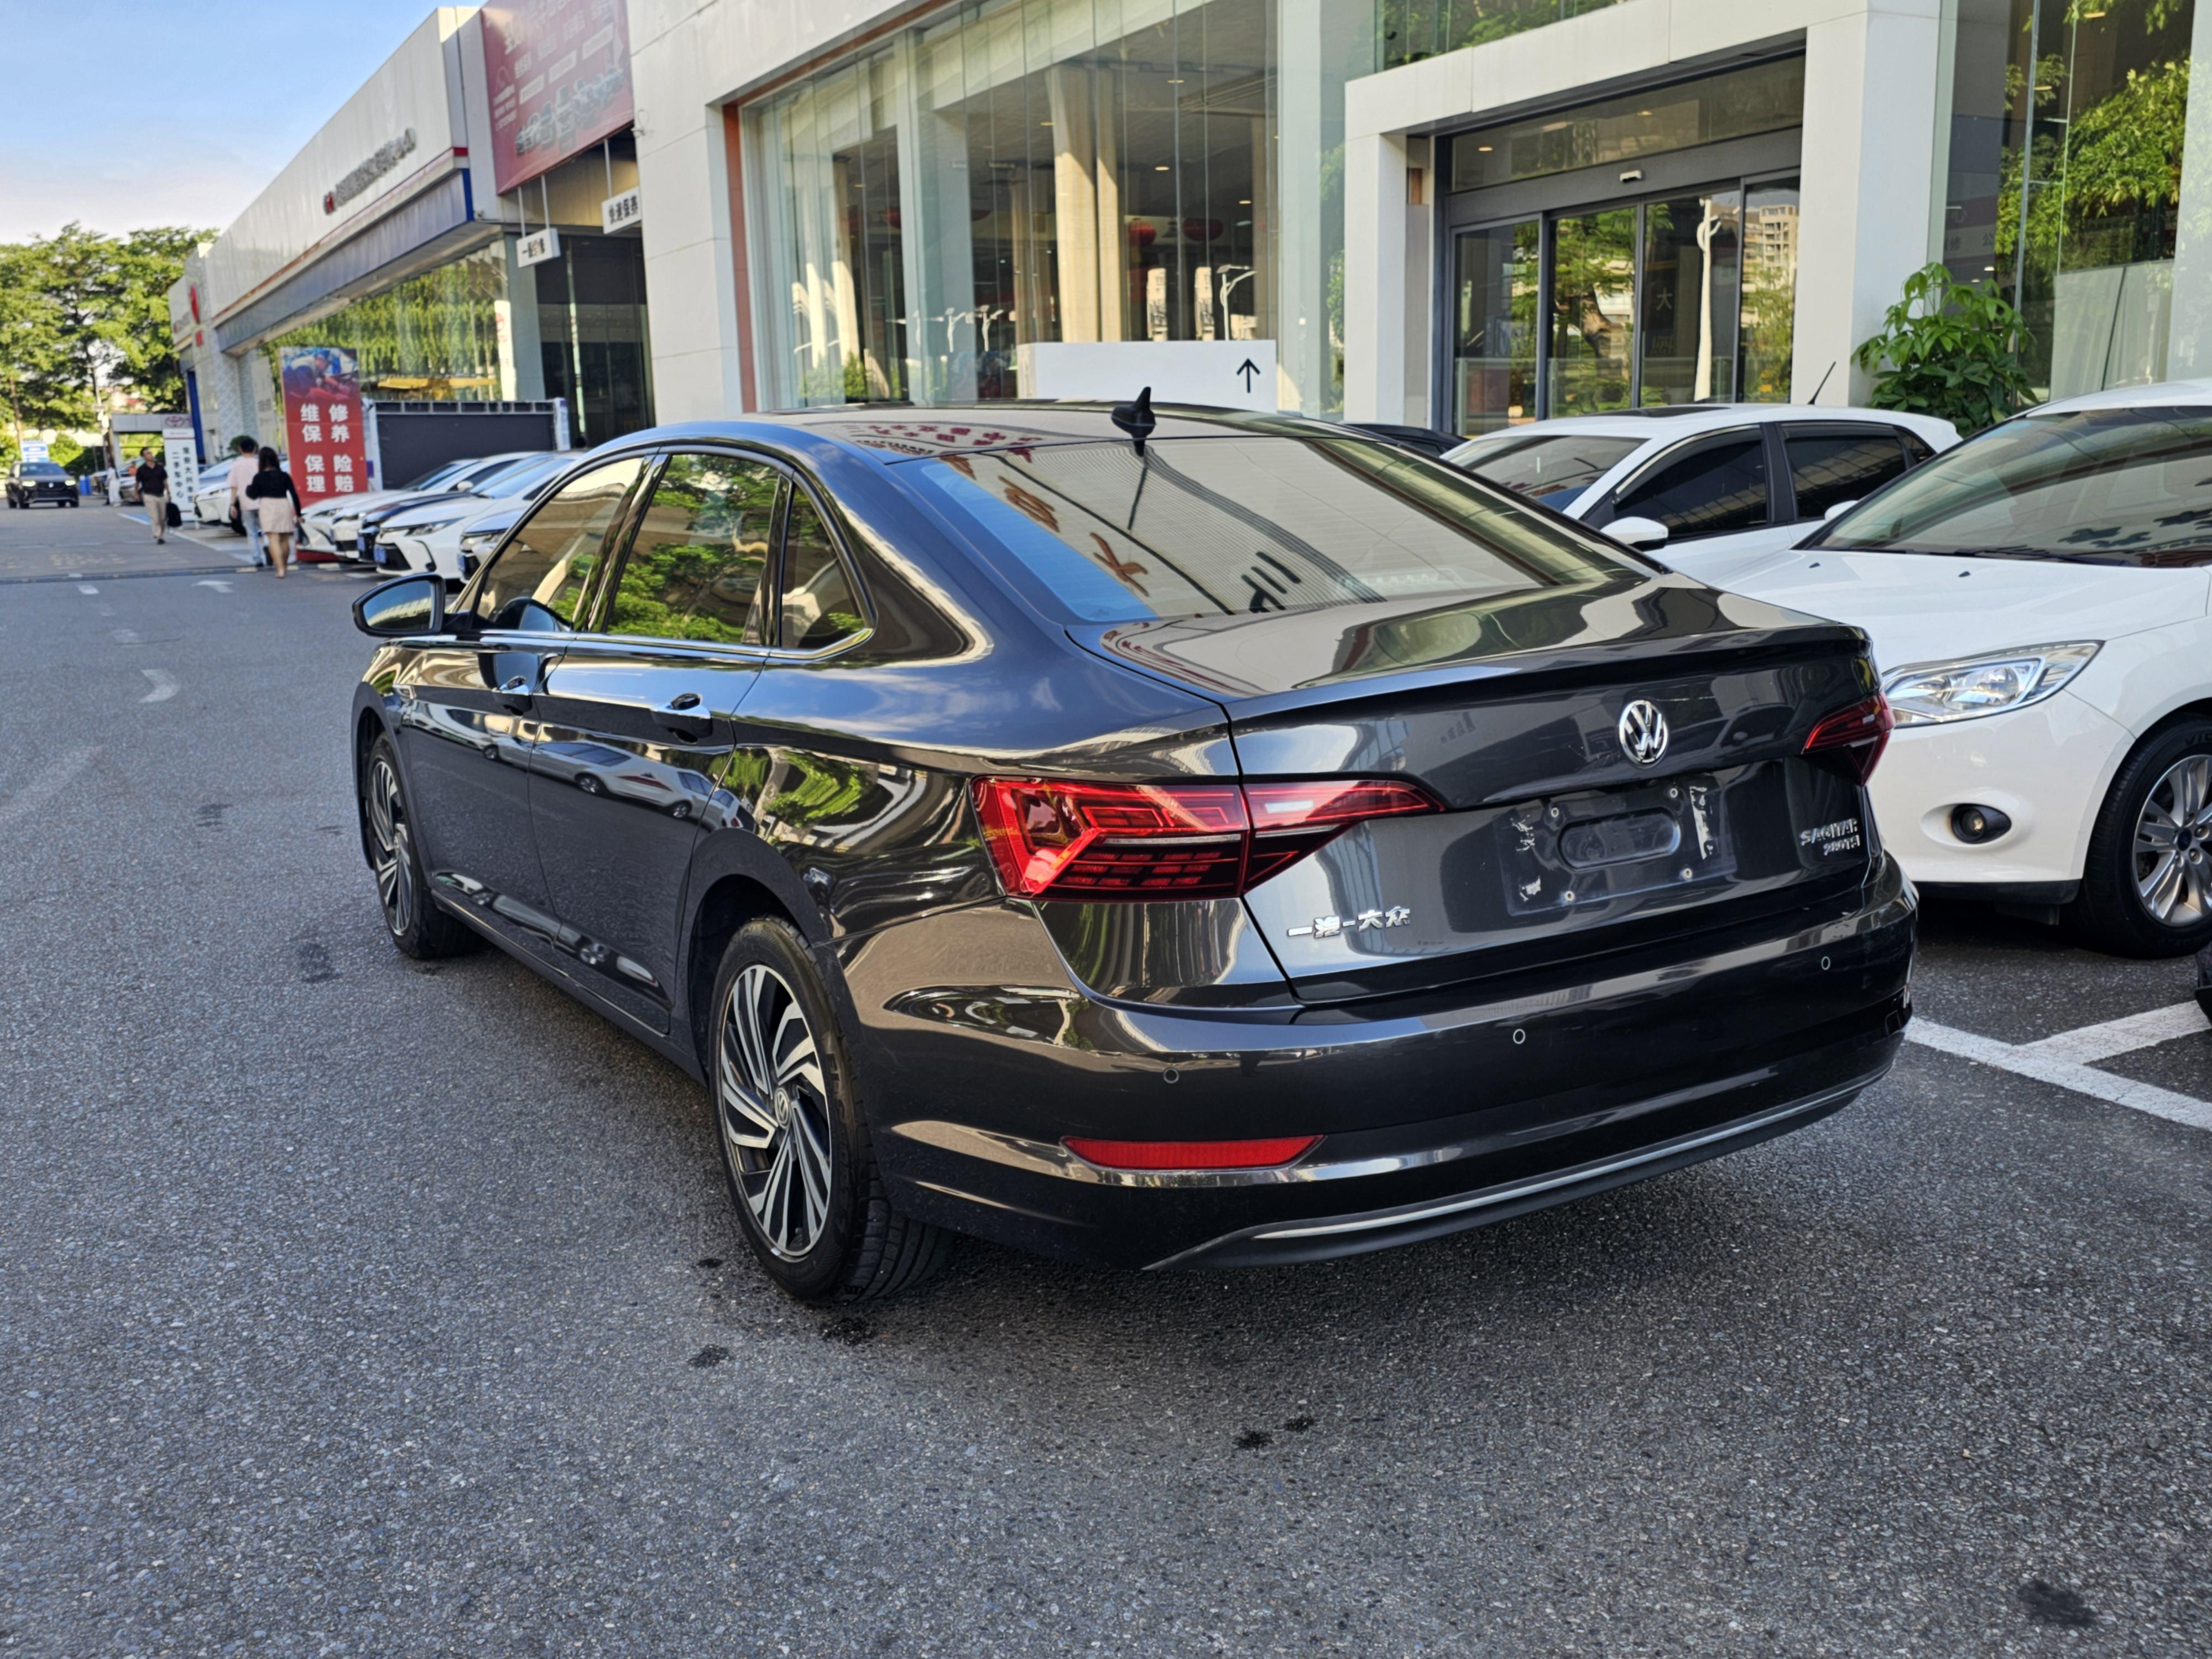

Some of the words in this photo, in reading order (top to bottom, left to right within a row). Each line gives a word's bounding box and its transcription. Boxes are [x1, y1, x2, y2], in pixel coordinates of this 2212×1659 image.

[300, 403, 348, 422] 维修
[301, 424, 350, 443] 保养
[305, 454, 353, 473] 保险
[306, 474, 354, 493] 理赔
[1799, 818, 1858, 846] SAGITAR
